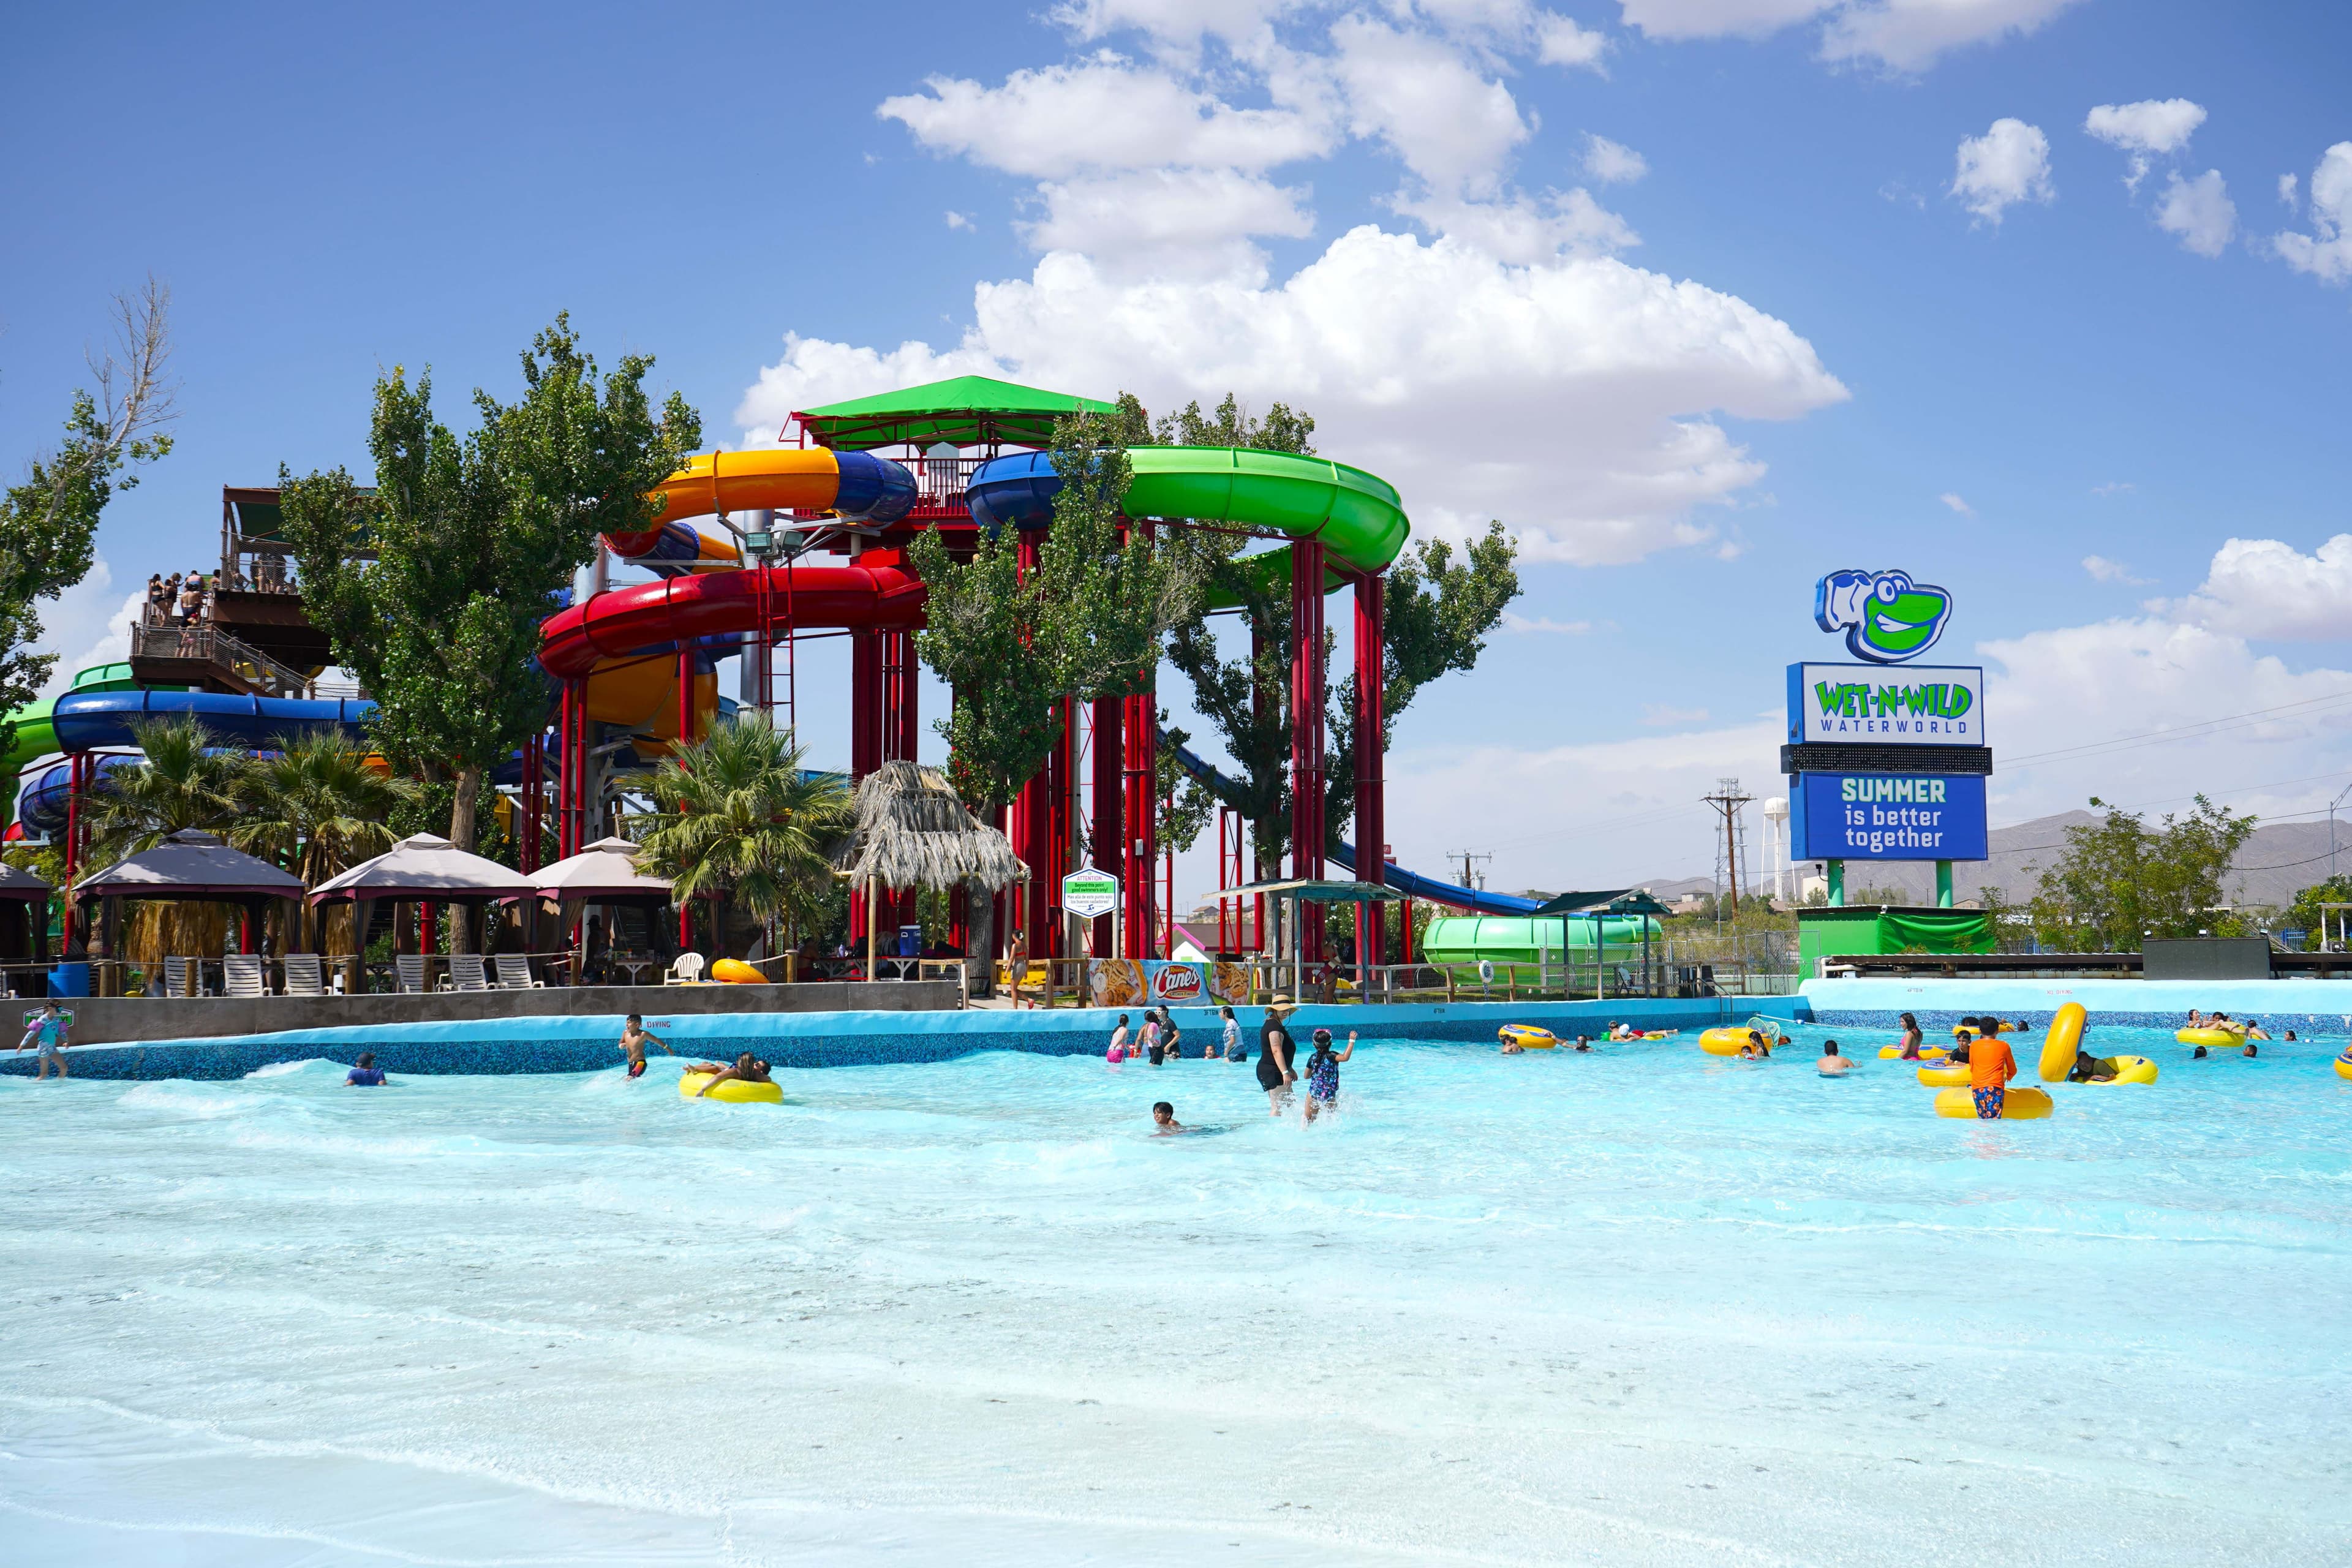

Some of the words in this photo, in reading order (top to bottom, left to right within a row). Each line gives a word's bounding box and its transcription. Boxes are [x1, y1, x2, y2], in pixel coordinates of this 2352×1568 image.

[1820, 719, 1967, 734] WATERWORLD
[1841, 777, 1947, 803] SUMMER
[1845, 804, 1865, 826] is
[1872, 804, 1942, 826] better
[1845, 826, 1943, 853] together
[1155, 965, 1199, 998] Cane's
